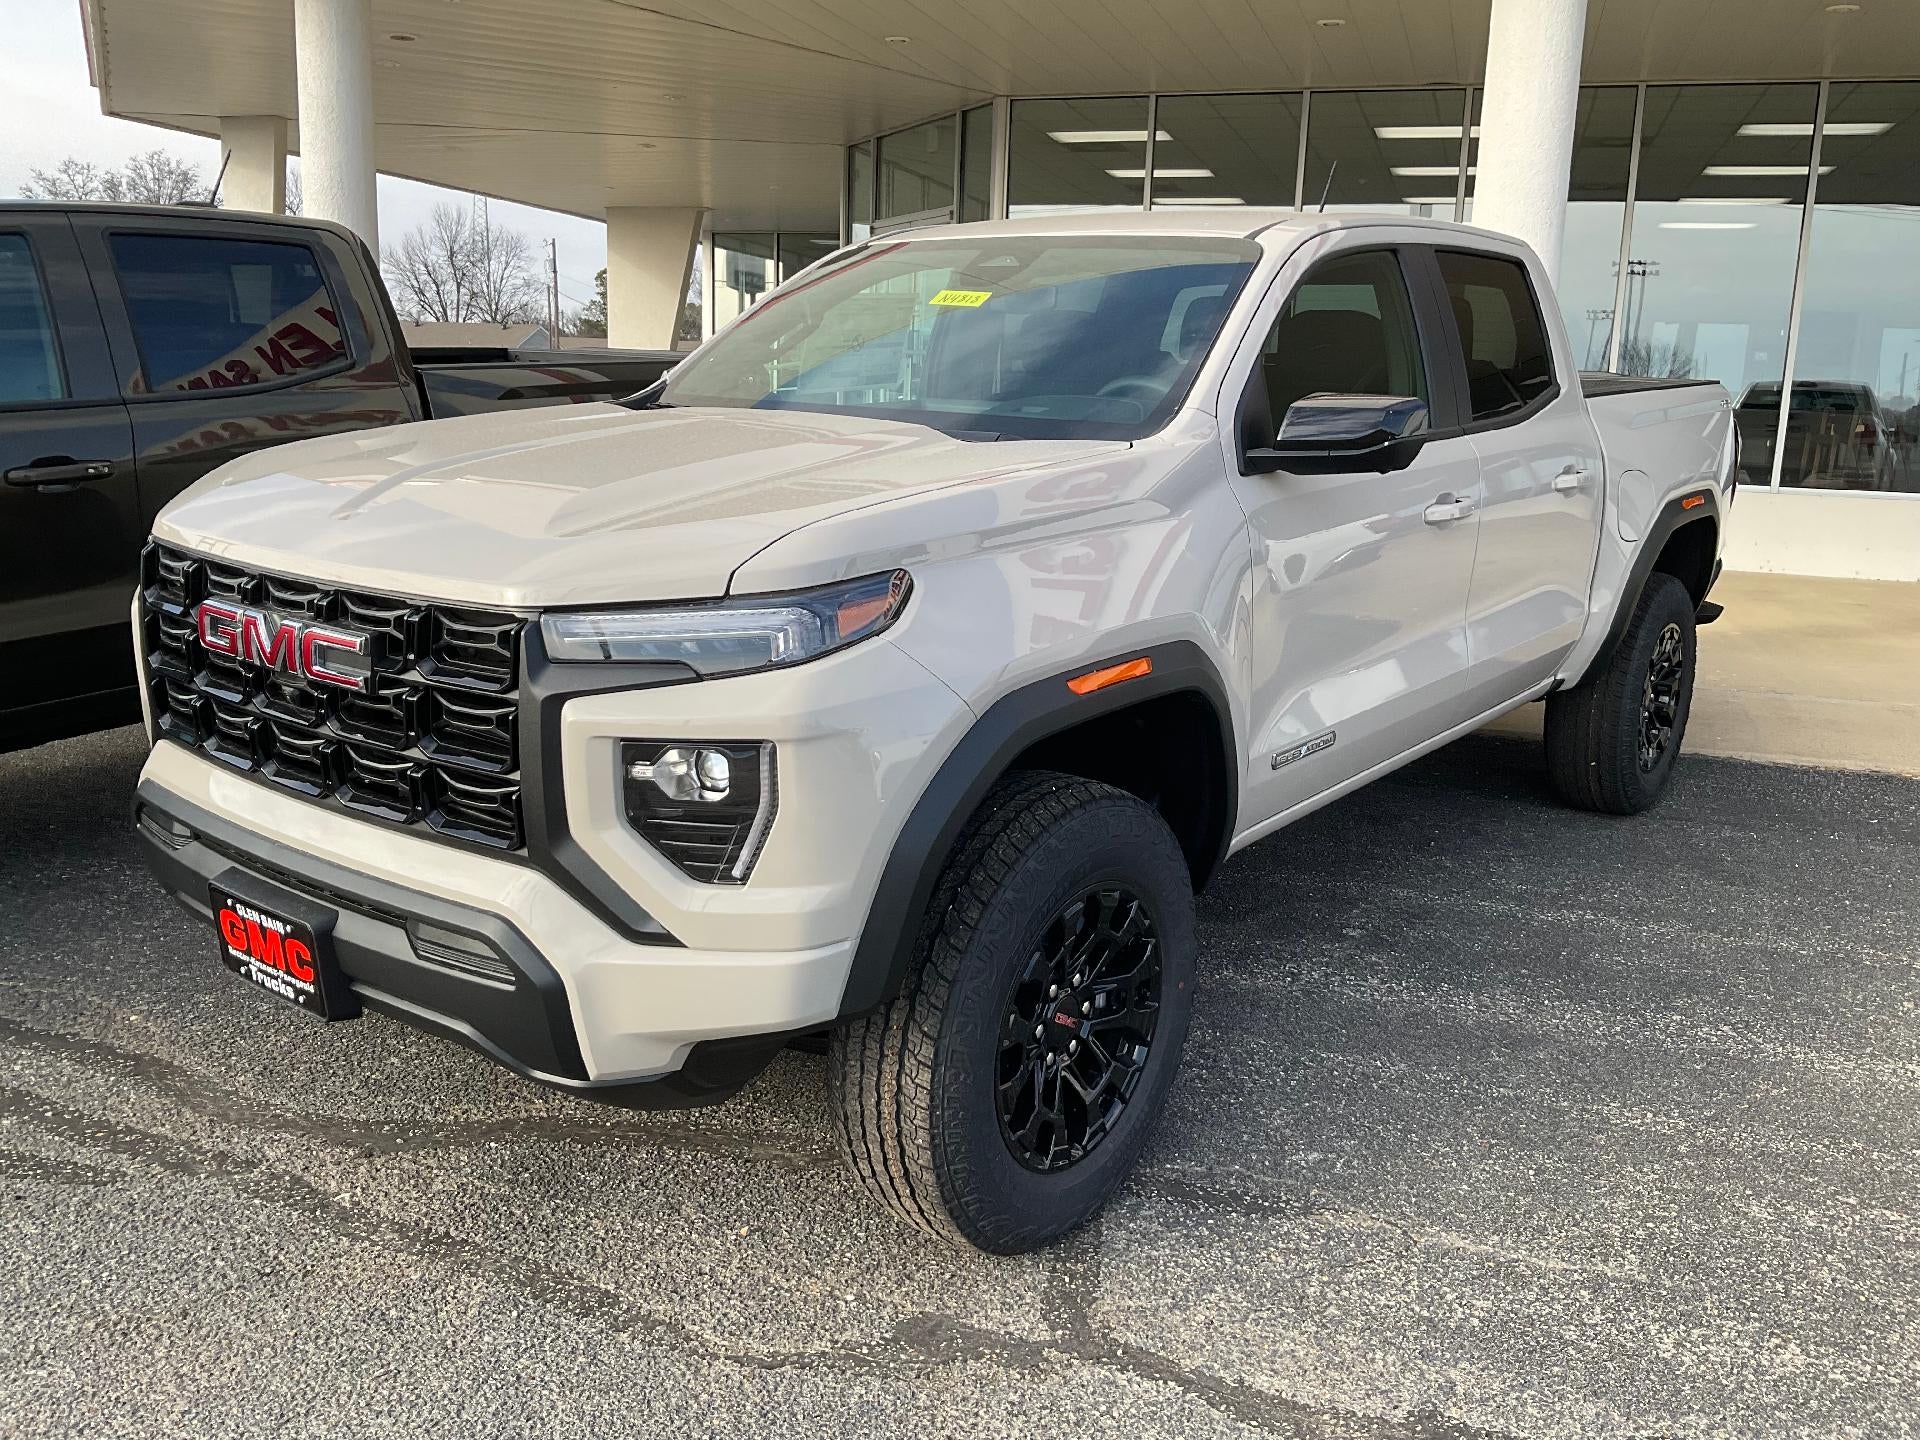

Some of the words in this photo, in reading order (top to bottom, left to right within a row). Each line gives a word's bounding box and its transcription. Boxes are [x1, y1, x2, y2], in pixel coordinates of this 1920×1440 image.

[198, 600, 370, 691] GMC
[235, 903, 260, 924] GLEN
[260, 914, 285, 935] SAIN
[219, 908, 315, 982] GMC
[248, 963, 295, 999] Trucks
[1054, 1012, 1077, 1029] GMC
